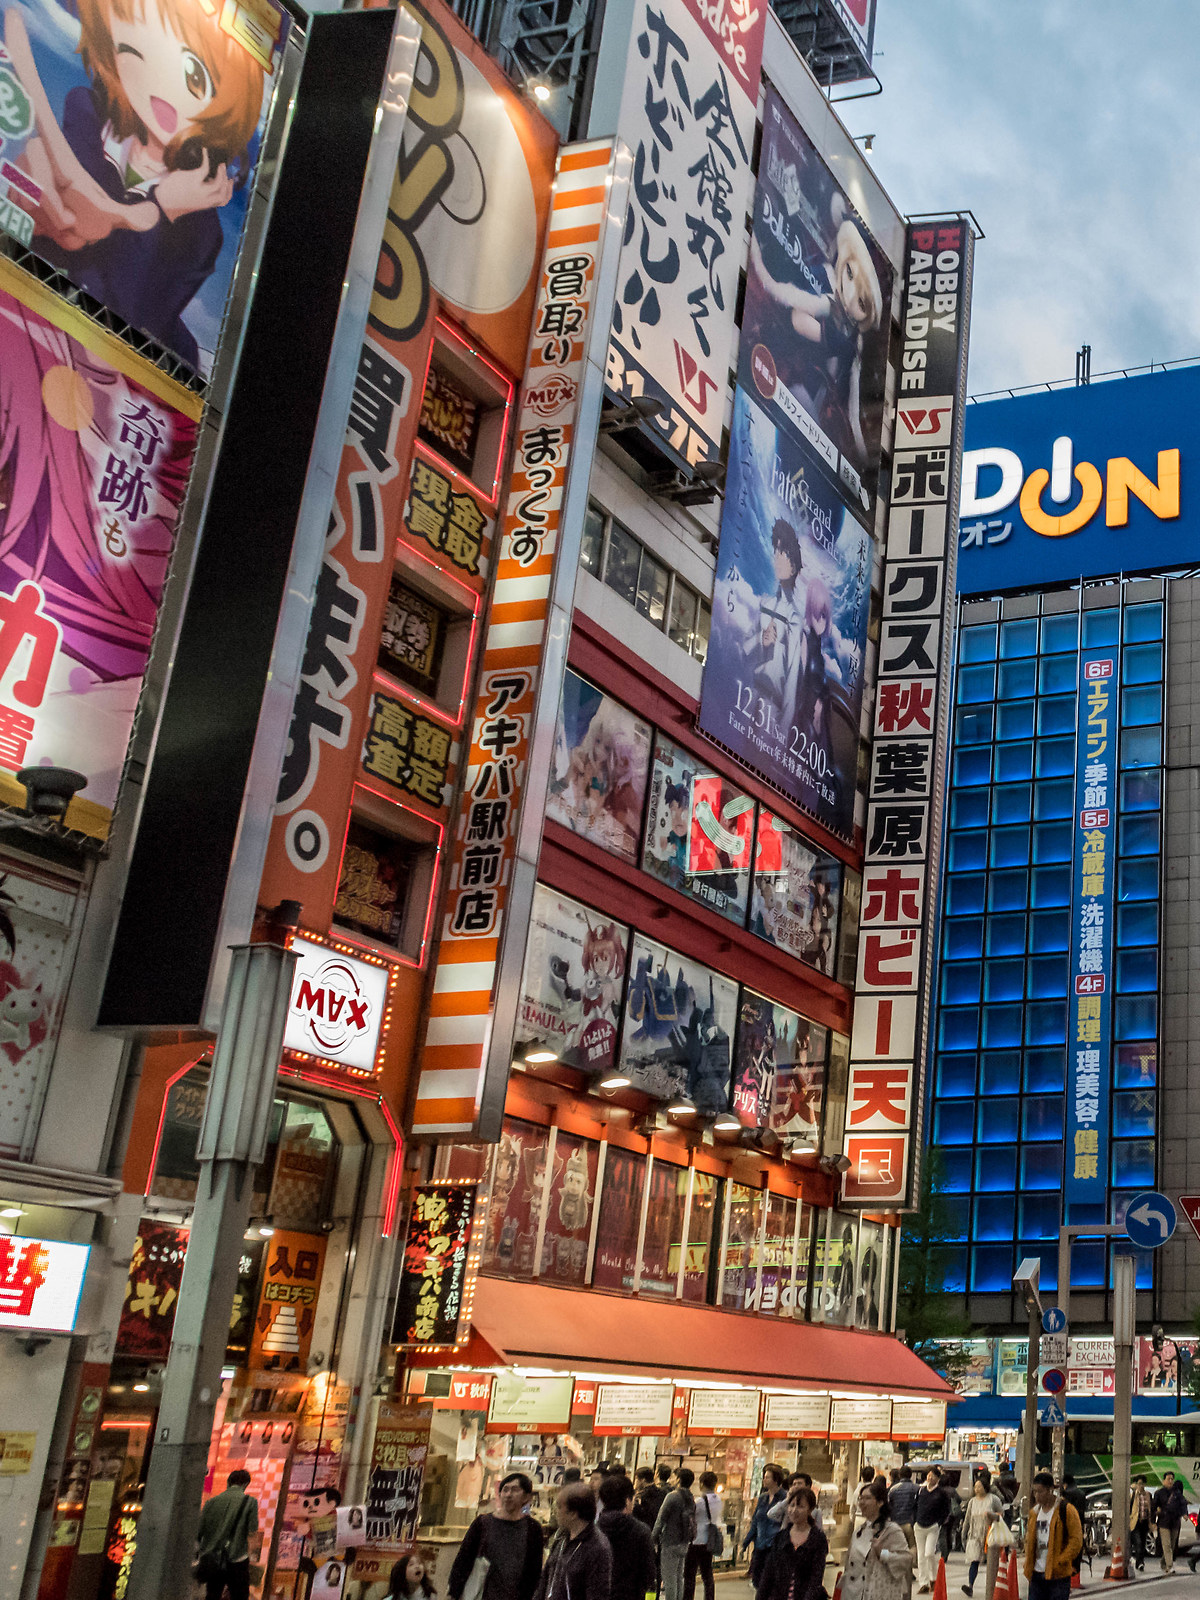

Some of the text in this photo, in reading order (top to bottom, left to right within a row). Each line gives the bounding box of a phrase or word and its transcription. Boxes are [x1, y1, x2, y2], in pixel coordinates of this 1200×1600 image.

[933, 227, 960, 333] HOBBY
[538, 256, 589, 365] 買取り
[901, 229, 933, 391] PARADISE
[513, 426, 562, 565] まっくす
[798, 479, 832, 532] Grand
[811, 516, 845, 566] Order
[1087, 662, 1110, 677] 6F
[734, 679, 772, 735] 12.31
[454, 677, 525, 931] アキバ駅前店
[1084, 811, 1107, 827] 5F
[296, 979, 368, 1031] MAX
[1078, 976, 1102, 993] 4F
[268, 1246, 320, 1282] 入口
[265, 1281, 317, 1303] はコチラ
